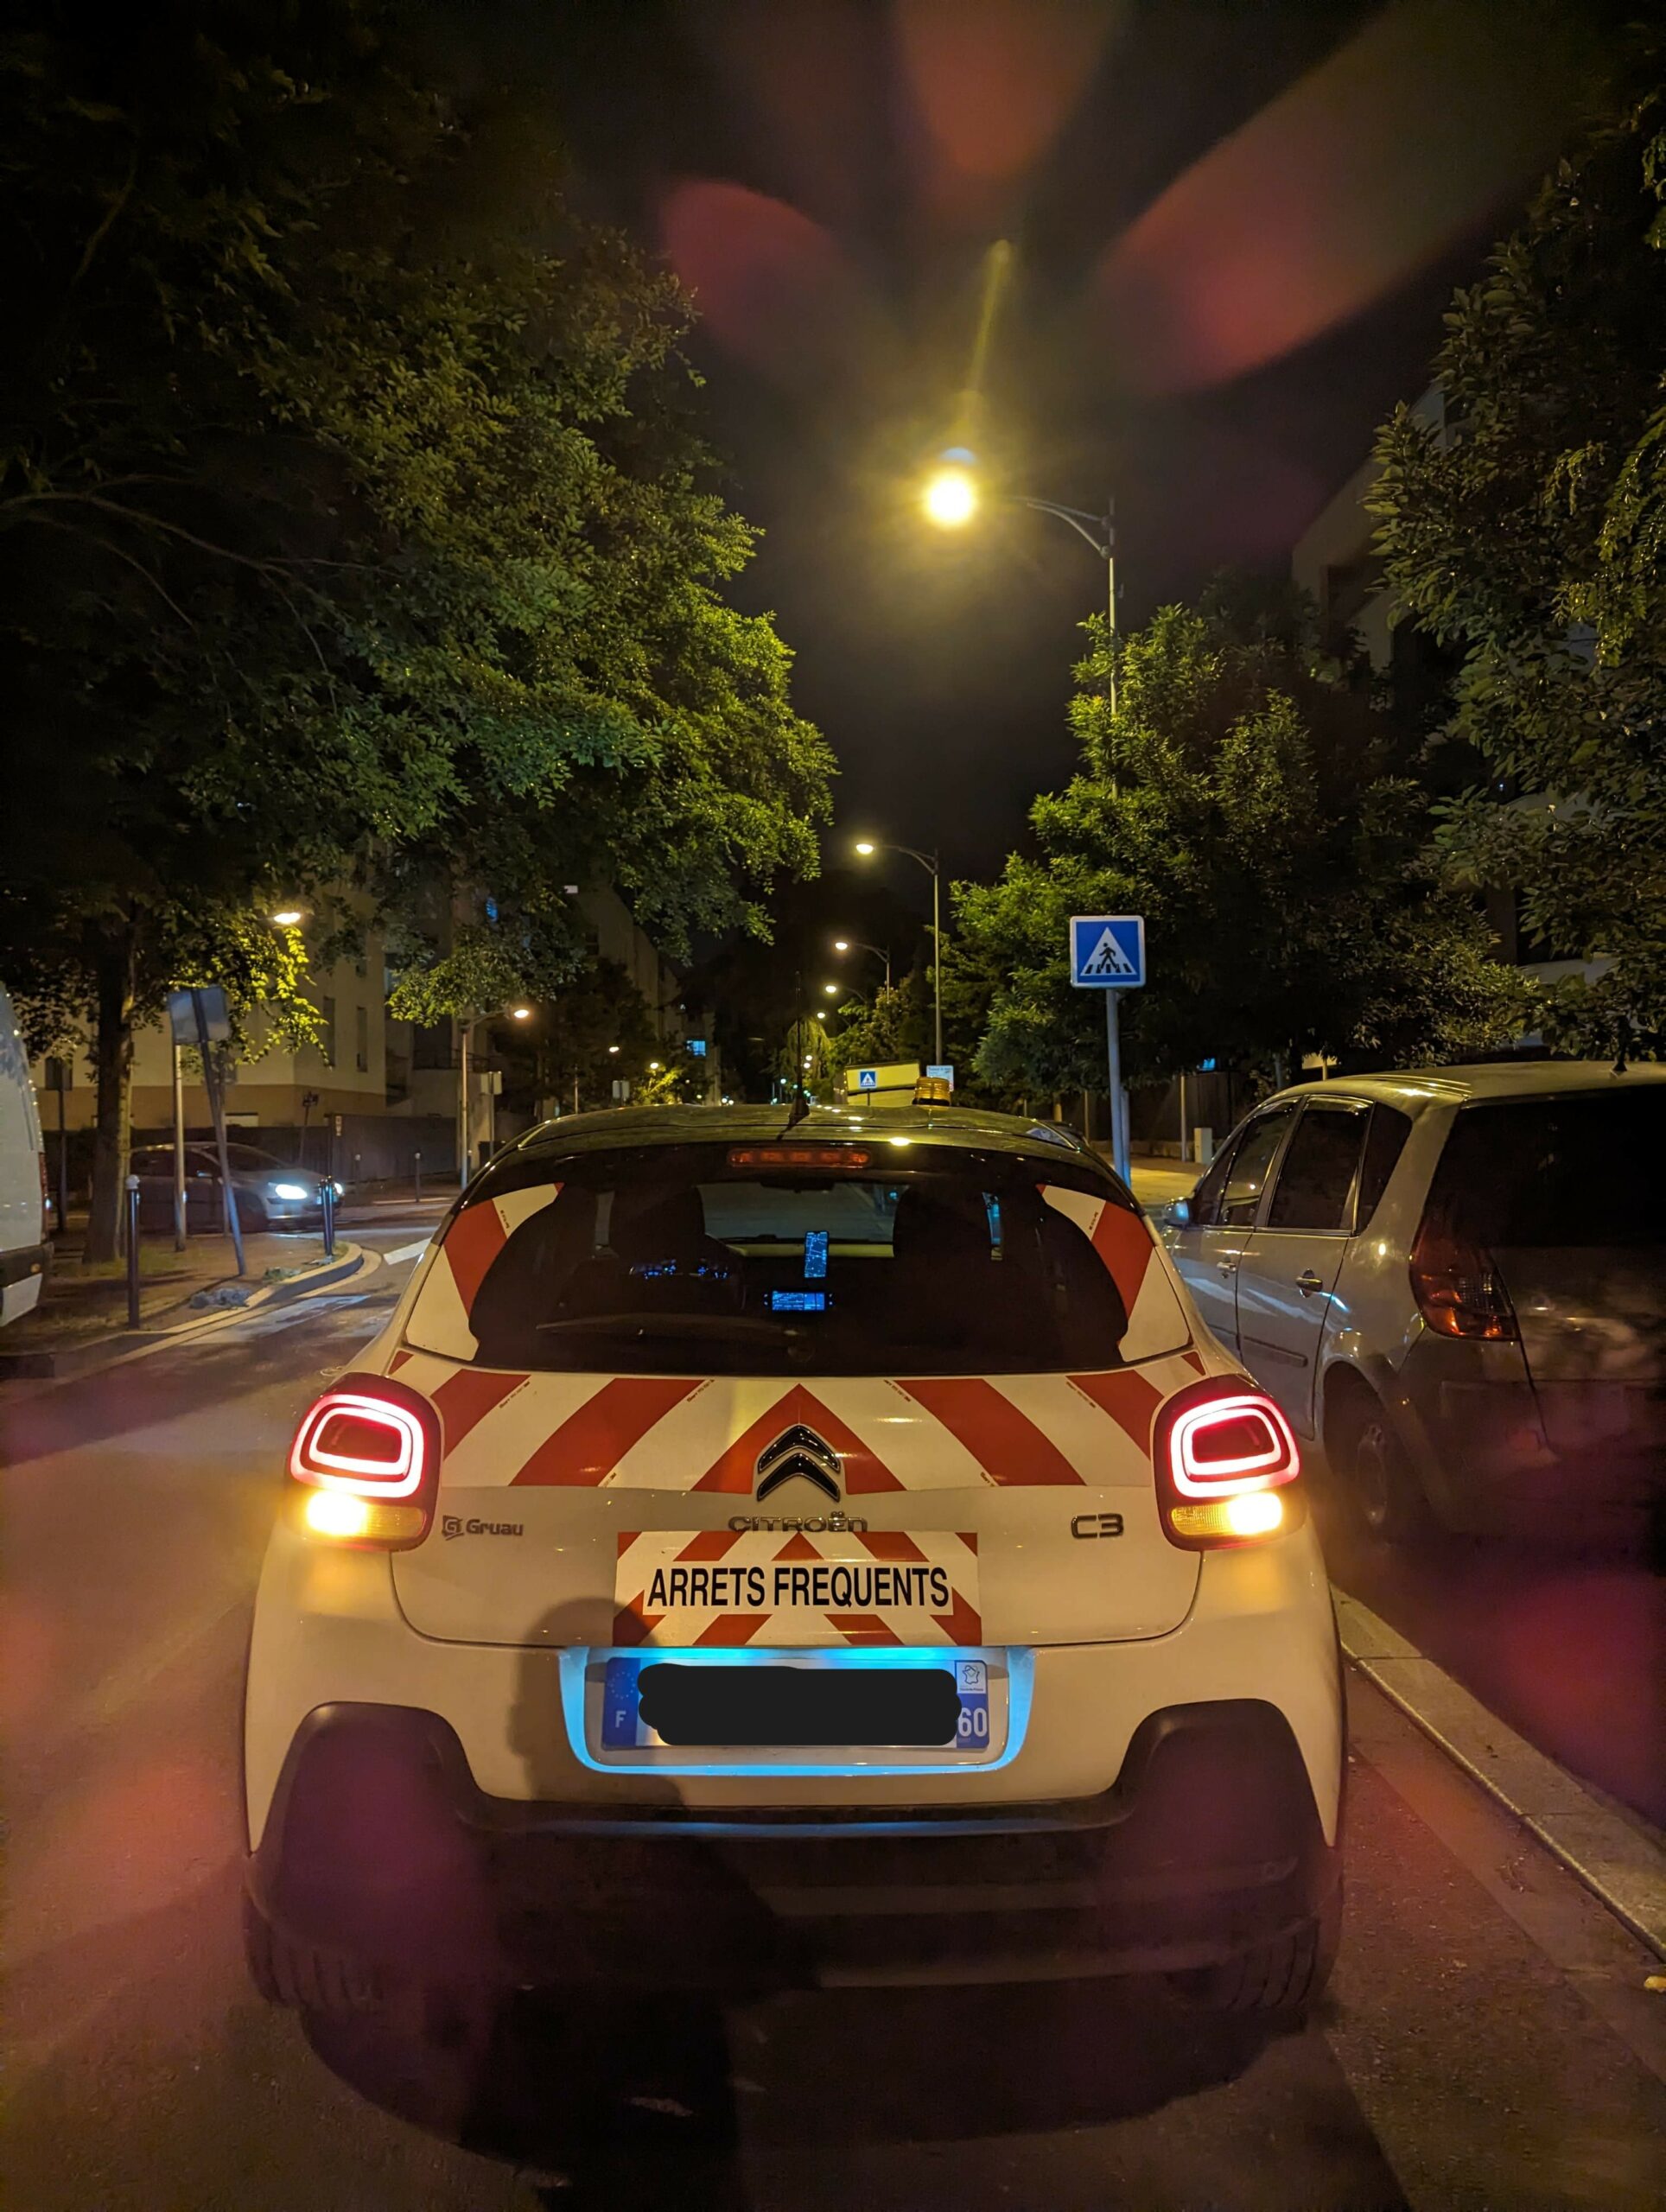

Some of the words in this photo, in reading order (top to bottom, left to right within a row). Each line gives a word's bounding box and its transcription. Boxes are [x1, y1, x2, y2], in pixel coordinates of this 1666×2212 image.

[467, 1519, 523, 1536] Gruau
[1071, 1513, 1123, 1539] C3
[647, 1567, 765, 1607] ARRETS
[774, 1567, 949, 1608] FREQUENTS
[615, 1710, 626, 1728] F
[957, 1707, 988, 1738] 60
